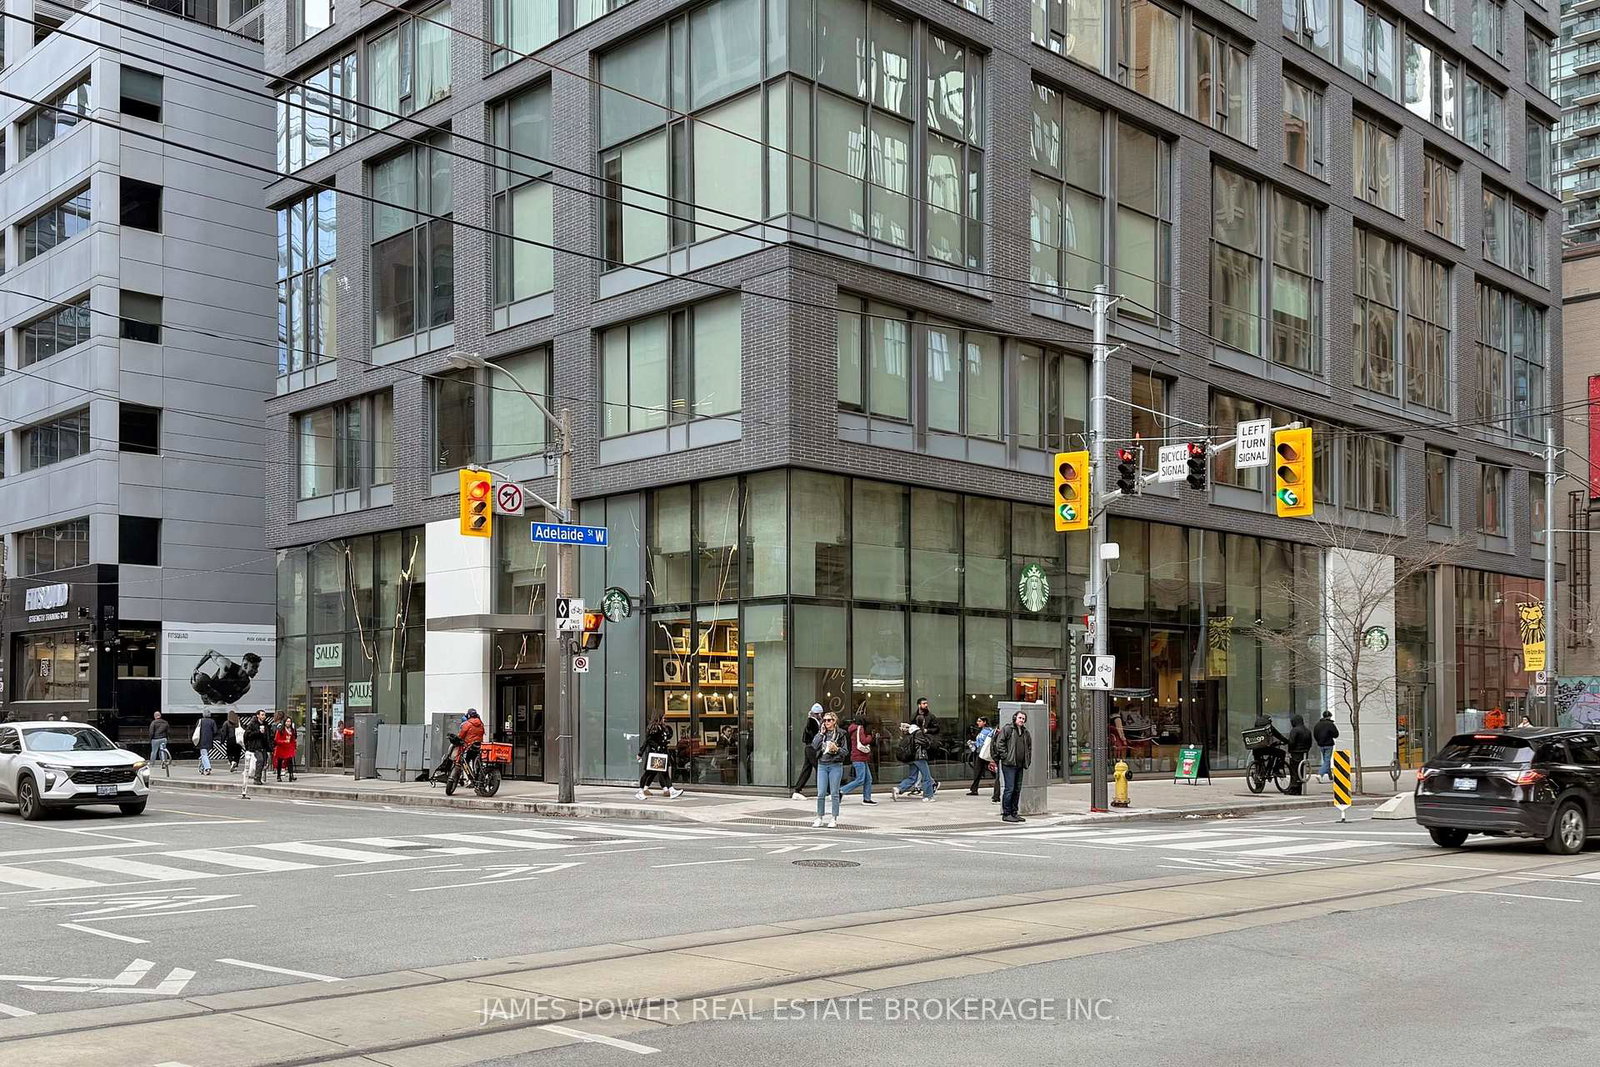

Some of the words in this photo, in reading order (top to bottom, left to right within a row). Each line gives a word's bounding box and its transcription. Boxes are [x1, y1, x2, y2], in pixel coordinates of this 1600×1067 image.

[1242, 425, 1265, 436] LEFT
[1241, 438, 1266, 449] TURN
[1161, 450, 1187, 463] BICYCLE
[1239, 451, 1267, 462] SIGNAL
[1161, 465, 1185, 476] SIGNAL
[535, 526, 584, 541] Adelaide
[595, 530, 605, 542] W
[315, 646, 339, 660] SALUS
[1070, 712, 1078, 763] COFFEE
